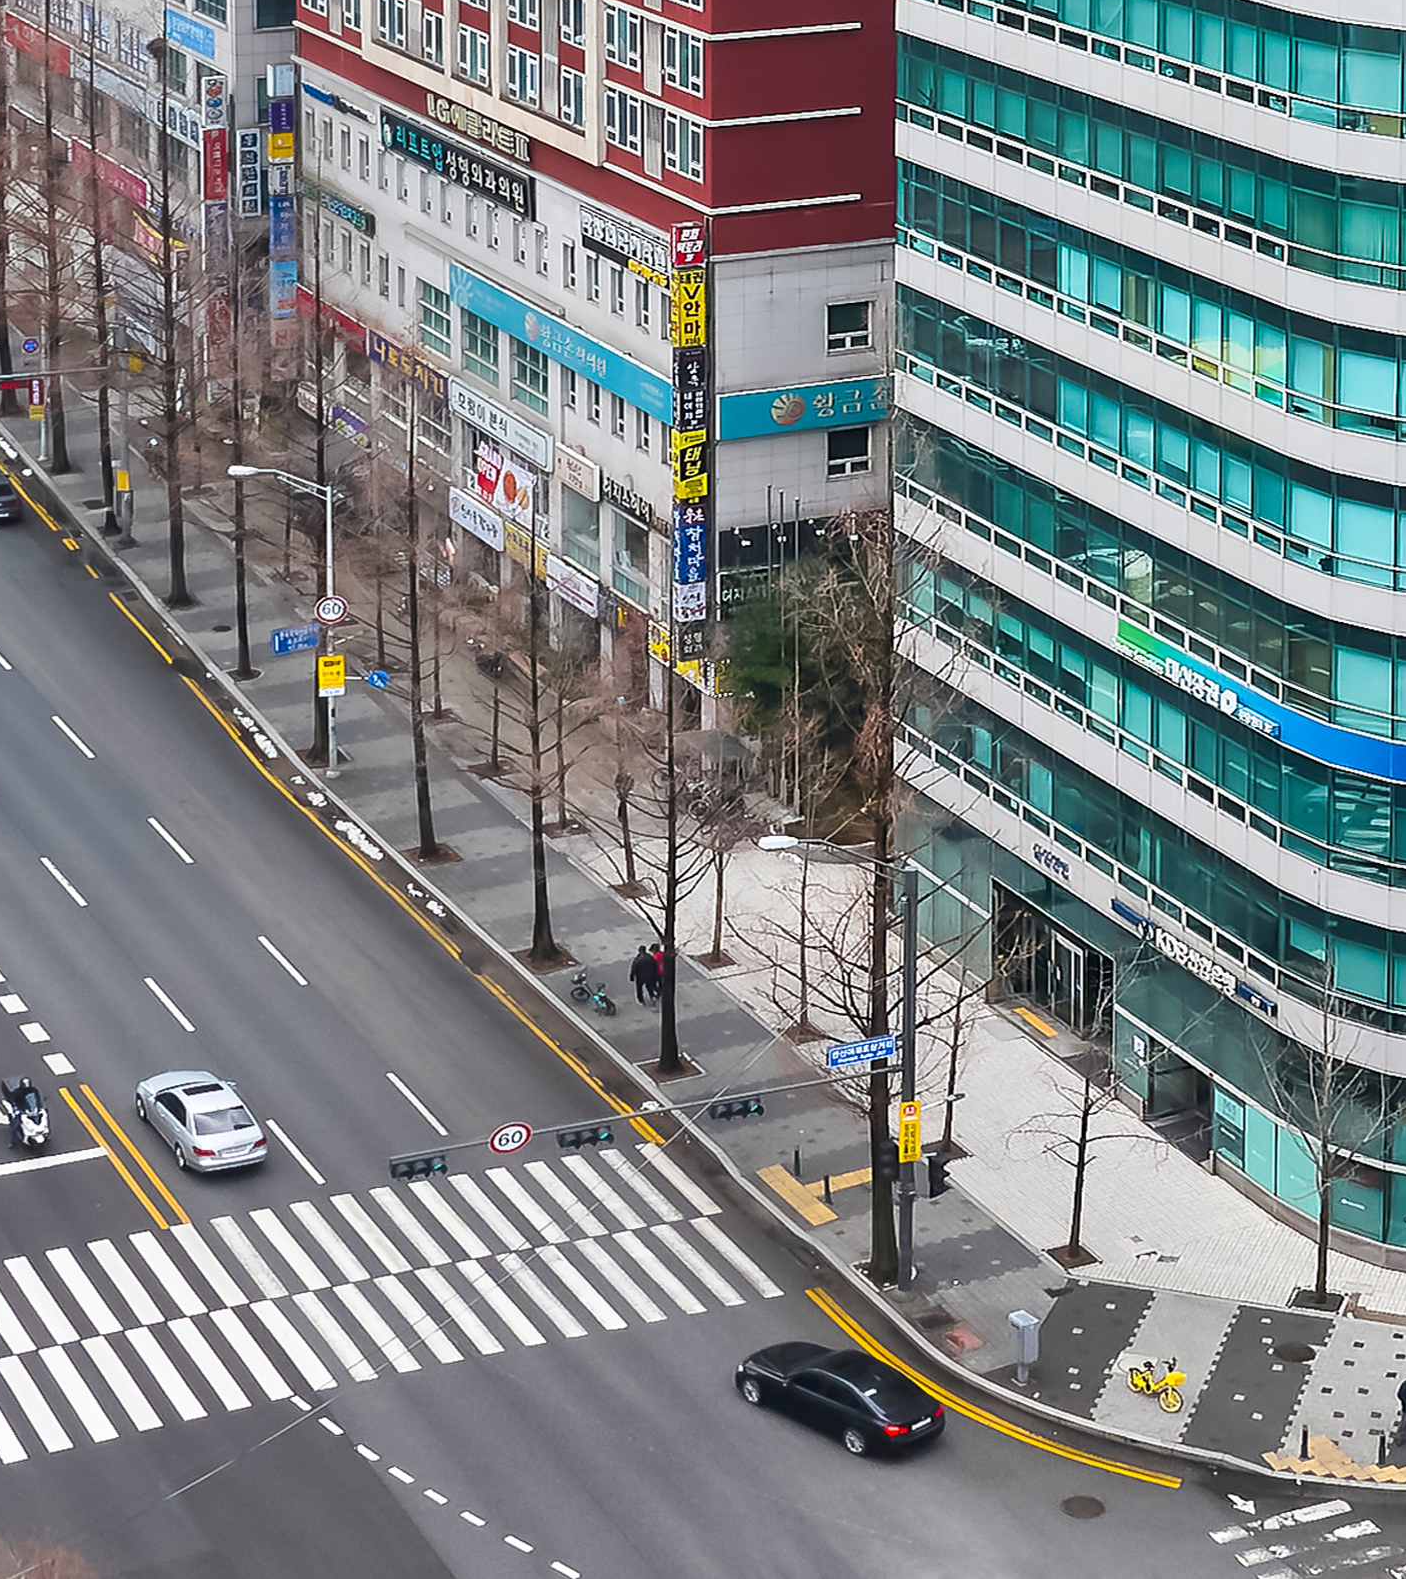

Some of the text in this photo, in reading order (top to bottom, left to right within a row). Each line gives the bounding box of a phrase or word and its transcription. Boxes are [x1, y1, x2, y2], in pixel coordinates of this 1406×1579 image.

[446, 150, 525, 213] 성형외과의원
[322, 602, 342, 615] 60
[1155, 928, 1236, 997] KDB산업은행
[498, 1130, 523, 1148] 60
